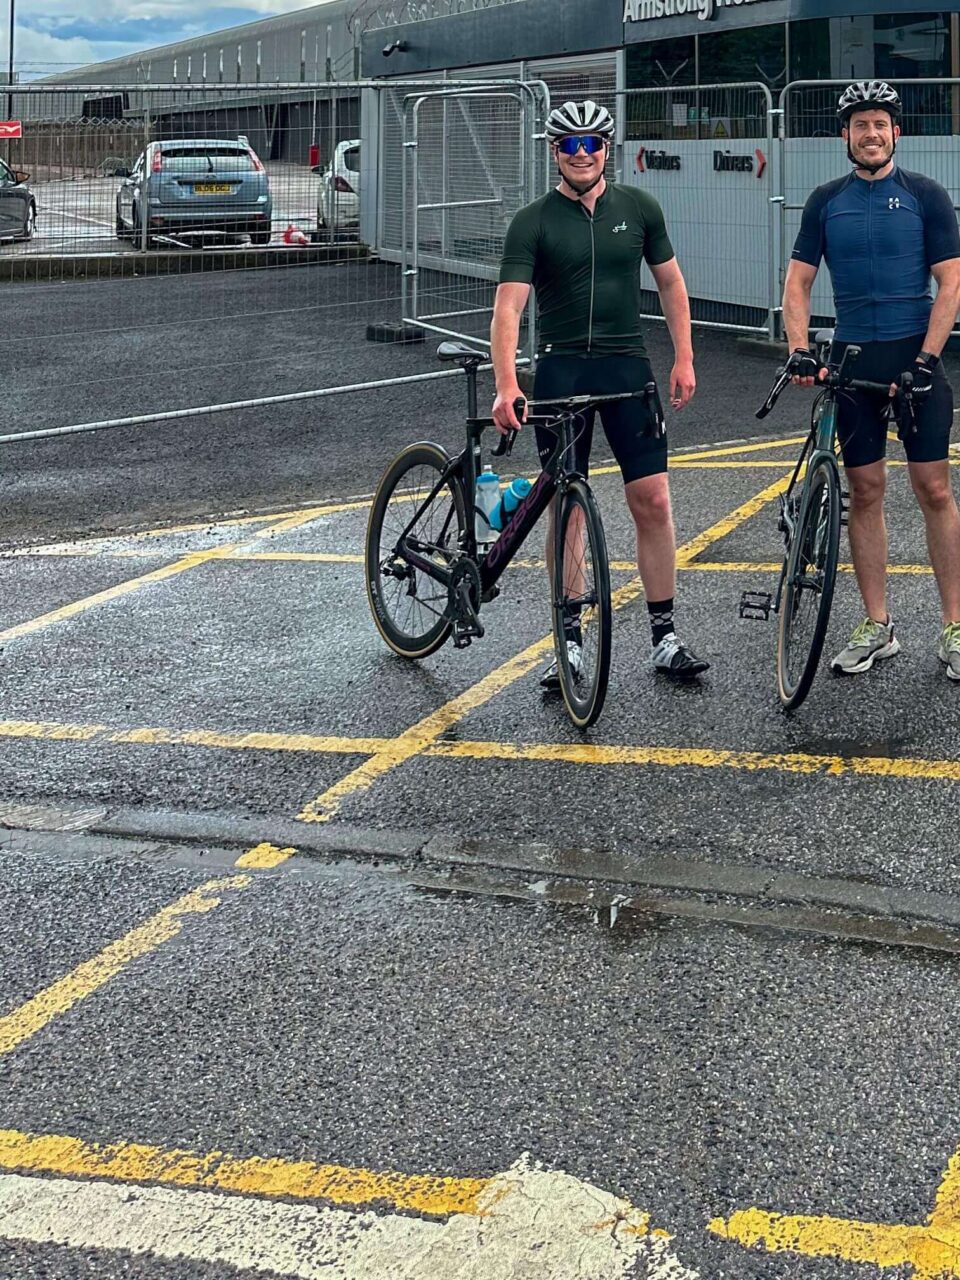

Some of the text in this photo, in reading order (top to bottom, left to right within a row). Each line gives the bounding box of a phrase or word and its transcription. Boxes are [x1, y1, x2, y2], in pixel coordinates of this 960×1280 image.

[645, 150, 681, 171] Visitors
[713, 149, 753, 172] Drivers
[487, 471, 552, 569] ORBEA
